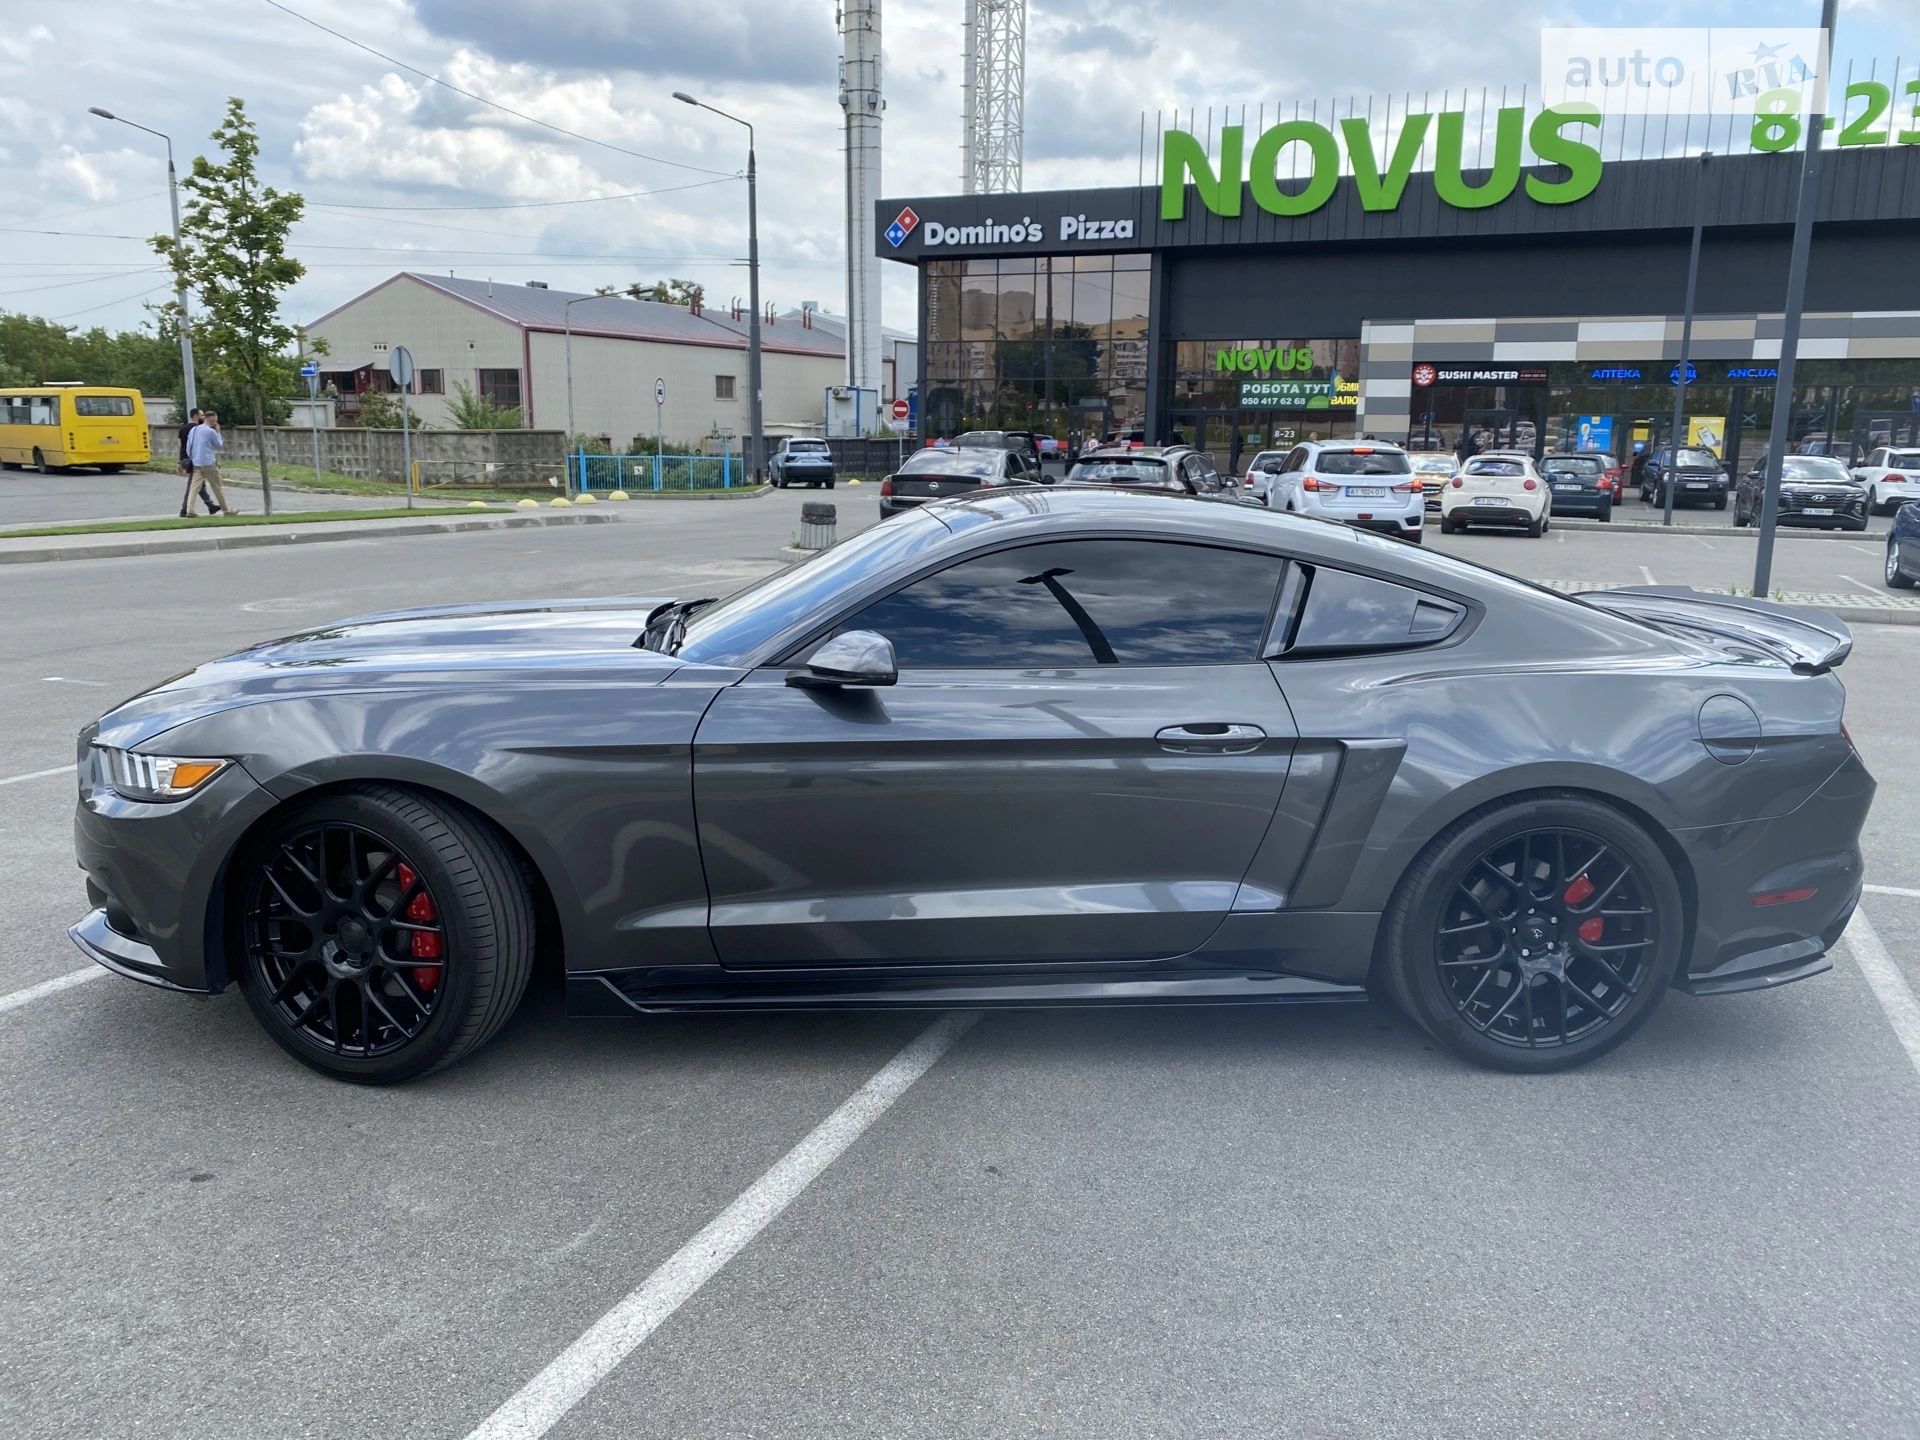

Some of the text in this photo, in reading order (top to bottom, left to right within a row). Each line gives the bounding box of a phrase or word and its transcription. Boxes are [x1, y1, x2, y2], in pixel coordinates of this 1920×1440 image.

[1161, 102, 1603, 220] NOVUS
[924, 214, 1134, 246] Domino's Pizza
[1216, 348, 1313, 371] NOVUS
[1438, 370, 1471, 379] SUSHI
[1473, 370, 1518, 379] MASTER
[1592, 369, 1641, 378] АПТЕКА
[1670, 369, 1697, 379] АЦ
[1727, 369, 1777, 378] ANC.UA
[1242, 384, 1330, 394] РОБОТА ТУТ
[1242, 397, 1259, 405] 050
[1261, 397, 1277, 405] 417
[1280, 397, 1292, 405] 62
